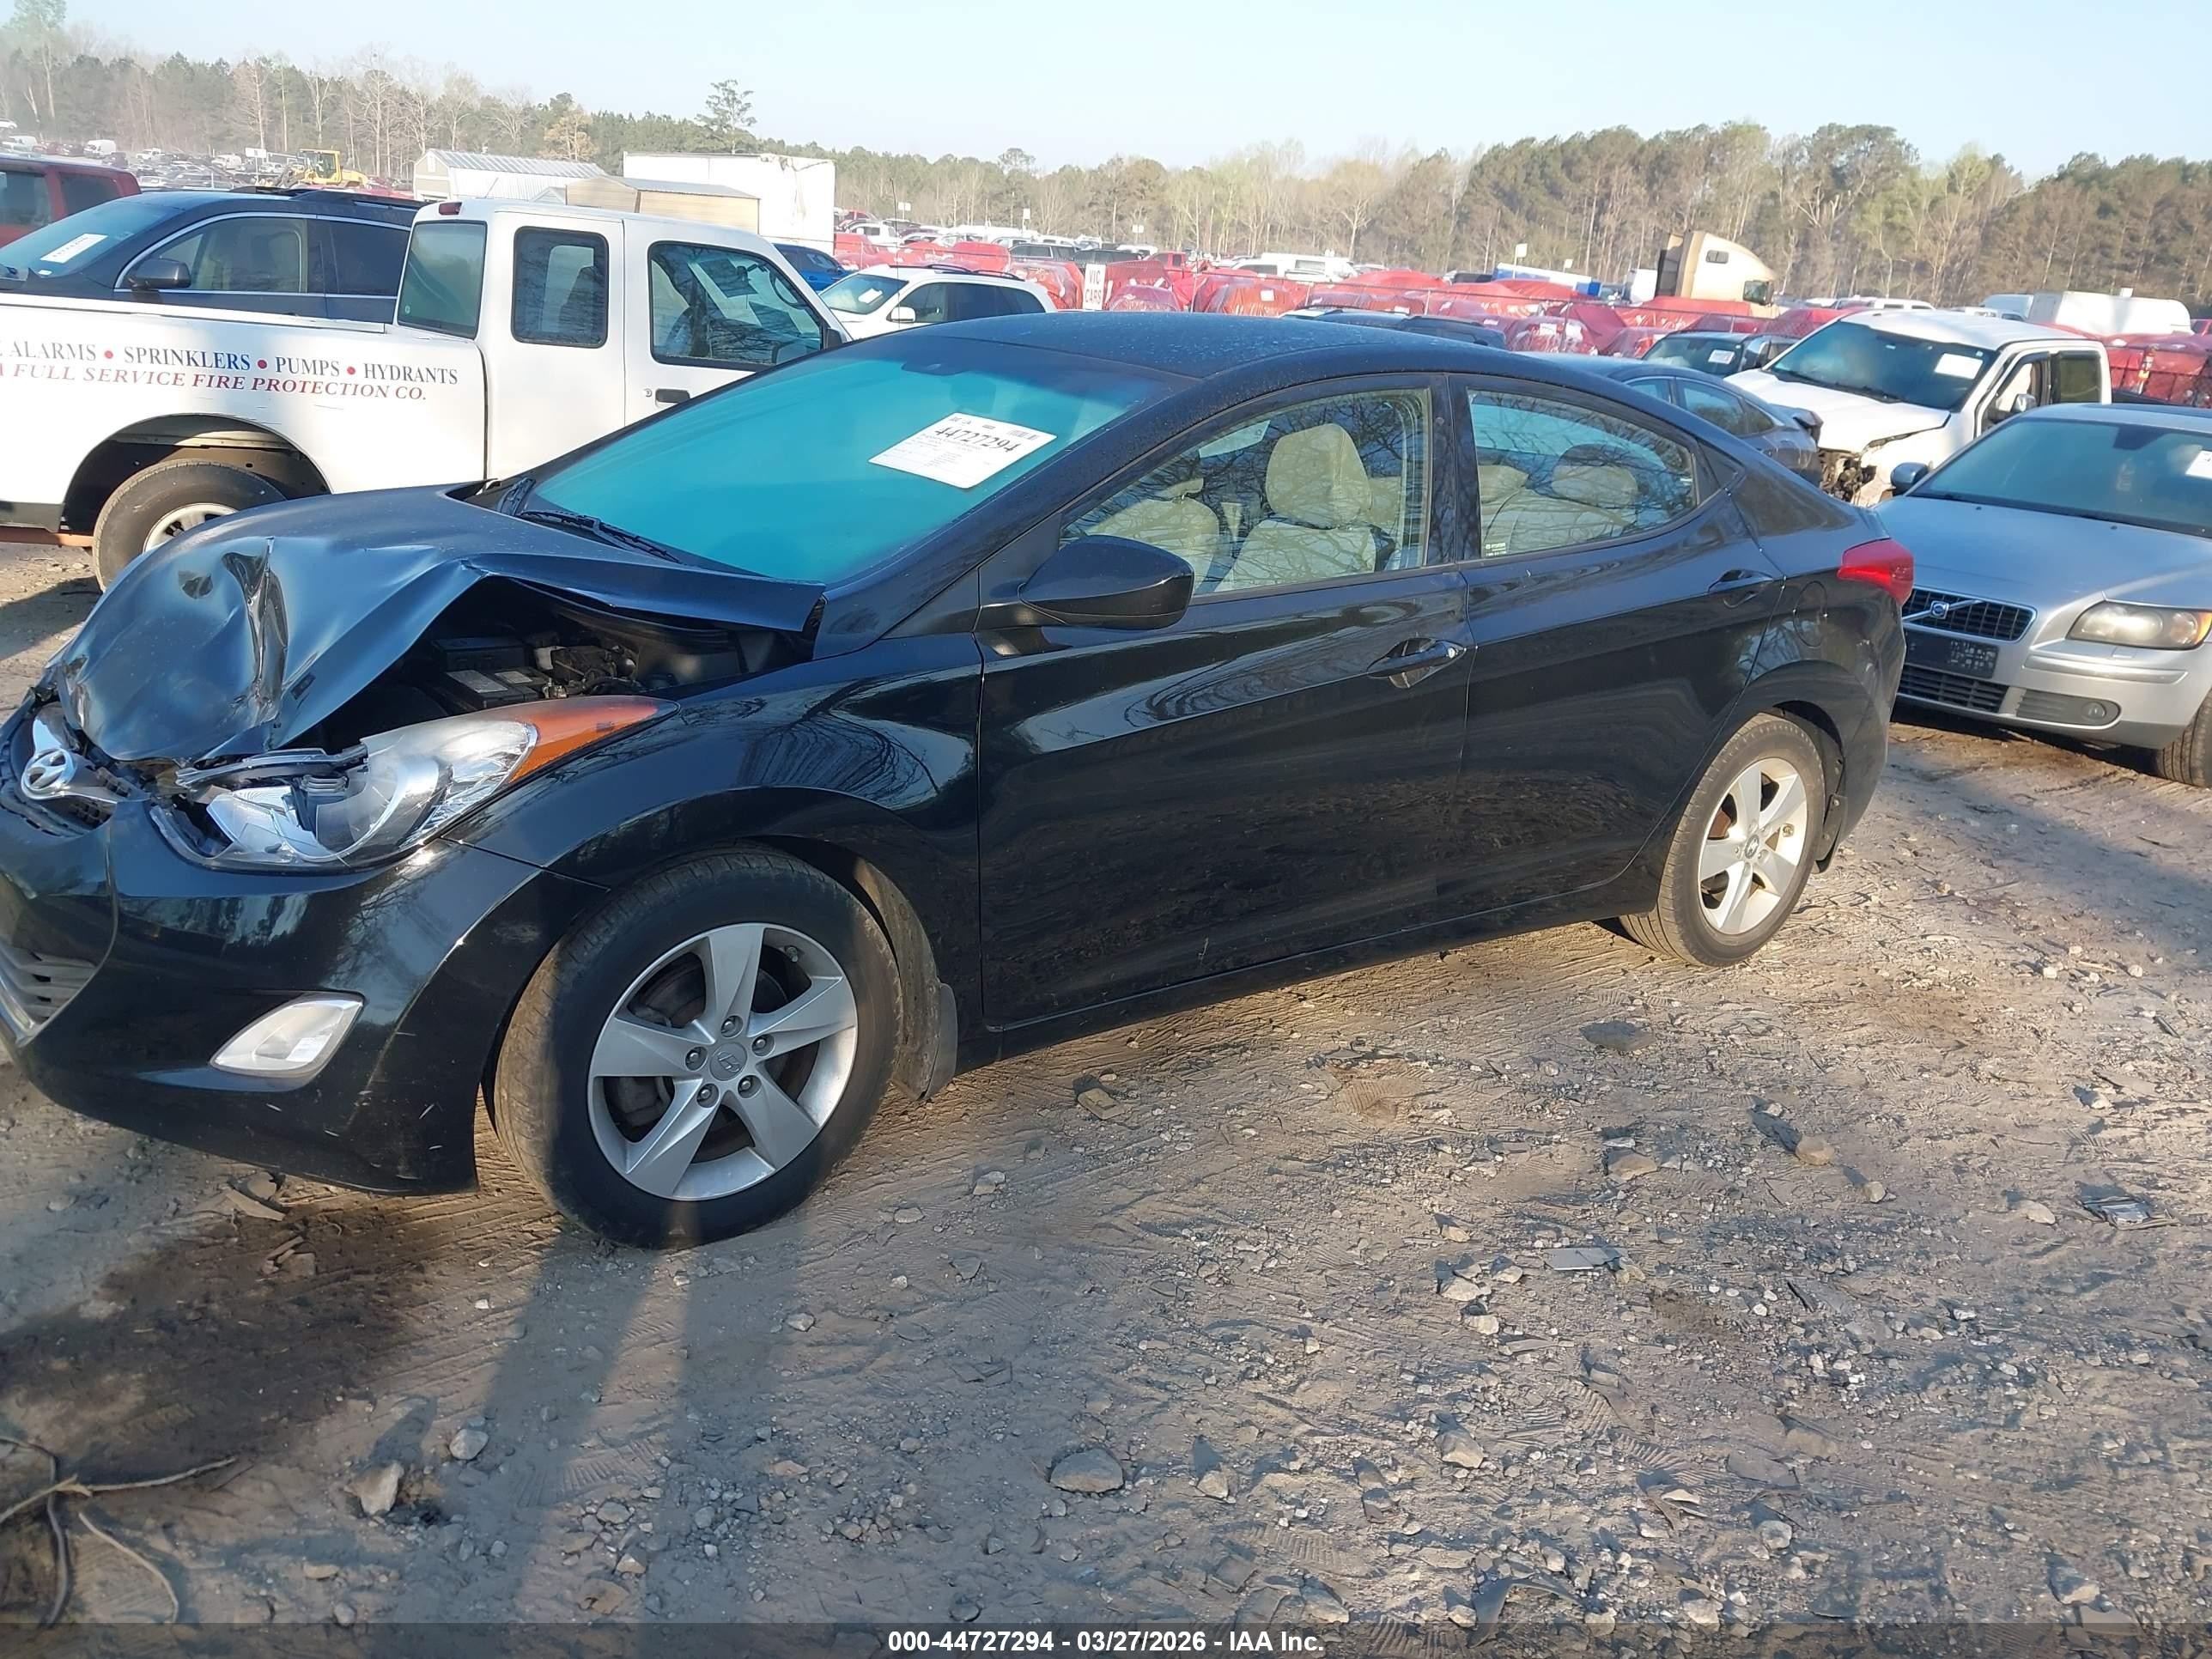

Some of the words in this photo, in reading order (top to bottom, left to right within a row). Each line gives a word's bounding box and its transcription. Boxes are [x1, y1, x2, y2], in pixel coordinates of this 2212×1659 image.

[1090, 270, 1101, 284] VIC
[1085, 289, 1102, 305] CARS
[9, 340, 97, 361] ALARMS
[124, 346, 251, 371] SPRINKLERS
[275, 356, 340, 377] PUMPS
[364, 362, 459, 385] HYDRANTS
[14, 363, 76, 380] FULL
[82, 367, 185, 386] SERVICE
[191, 374, 246, 390] FIRE
[251, 377, 390, 398] PROTECTION
[395, 386, 427, 400] CO.
[934, 426, 1022, 453] 44727294
